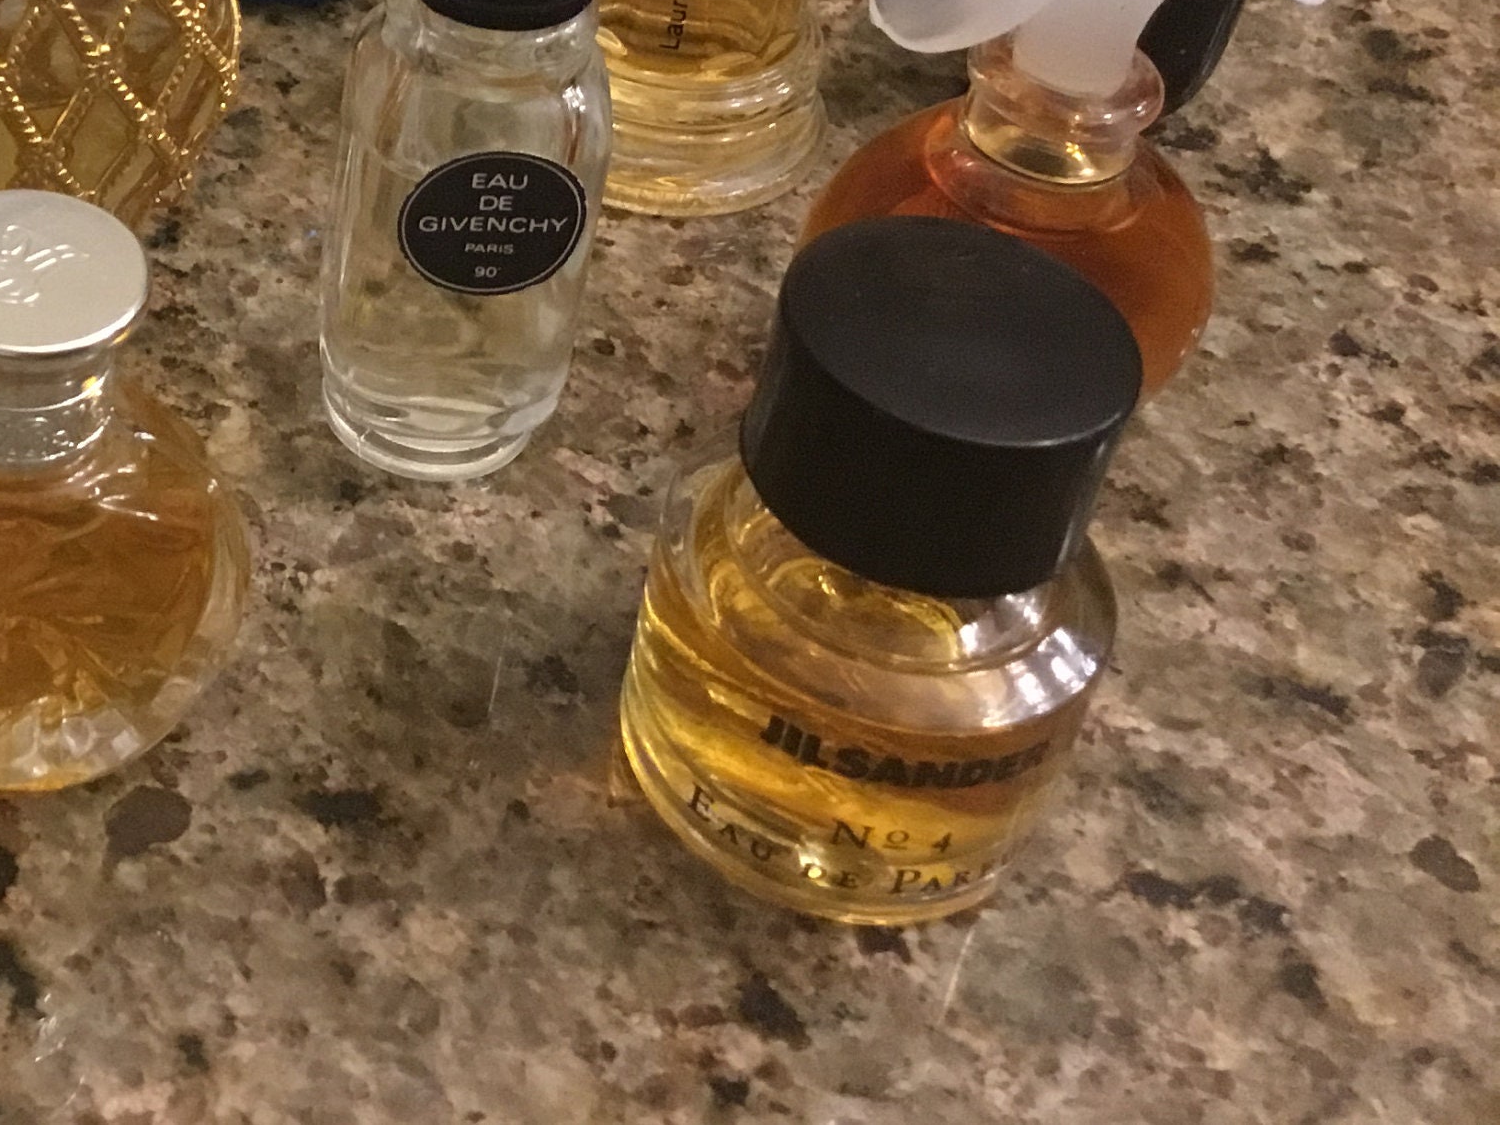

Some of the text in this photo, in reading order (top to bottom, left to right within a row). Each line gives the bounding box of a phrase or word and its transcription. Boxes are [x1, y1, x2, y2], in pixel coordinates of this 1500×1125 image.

[471, 173, 528, 190] EAU
[479, 195, 514, 211] DE
[418, 216, 568, 233] GIVENCHY
[464, 243, 514, 255] PARIS
[760, 713, 826, 769] JIL
[931, 831, 953, 854] 4
